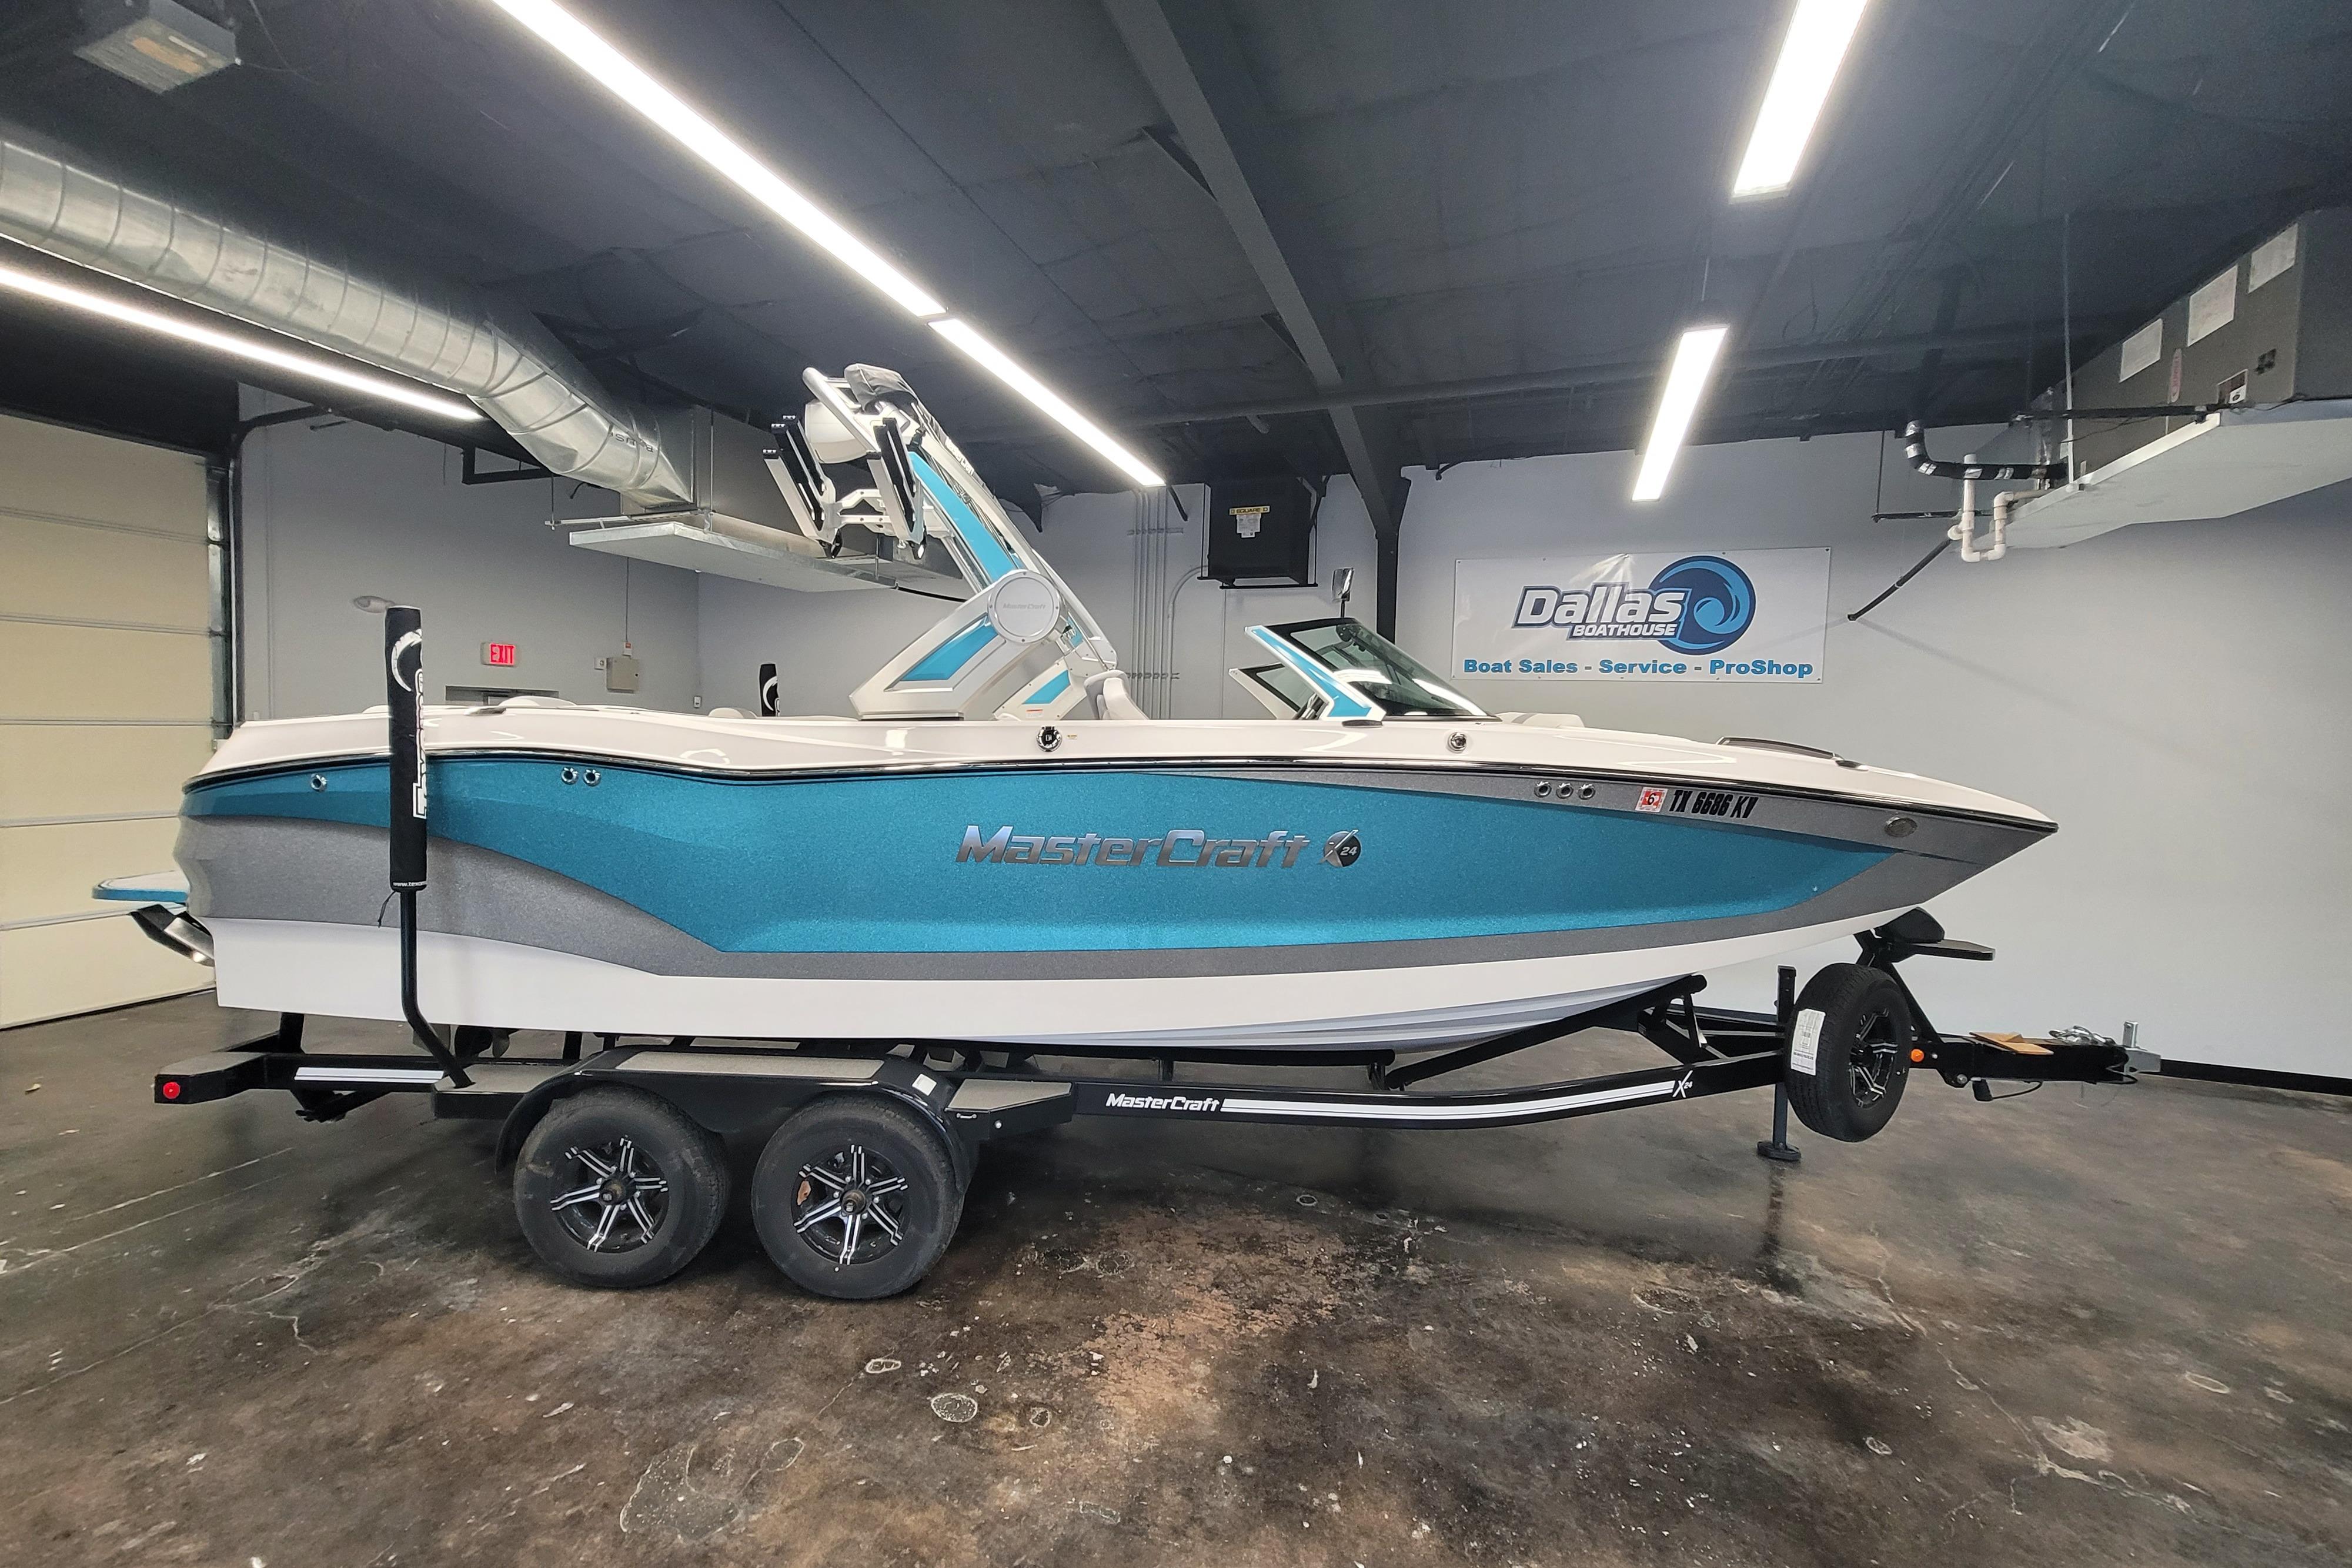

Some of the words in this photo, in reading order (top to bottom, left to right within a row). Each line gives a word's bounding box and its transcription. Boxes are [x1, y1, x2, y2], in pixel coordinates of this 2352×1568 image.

[1516, 586, 1685, 624] Dallas
[1572, 624, 1678, 637] BOATHOUSE
[490, 644, 514, 664] EXIT
[1464, 659, 1512, 673] Boat
[1519, 659, 1578, 673] Sales
[1599, 659, 1688, 674] Service
[1709, 660, 1813, 678] ProShop
[1647, 793, 1656, 805] 6
[1669, 790, 1693, 813] TX
[1691, 791, 1734, 816] 6686
[956, 825, 1310, 868] MasterCraft
[1105, 1092, 1220, 1112] MasterCraft
